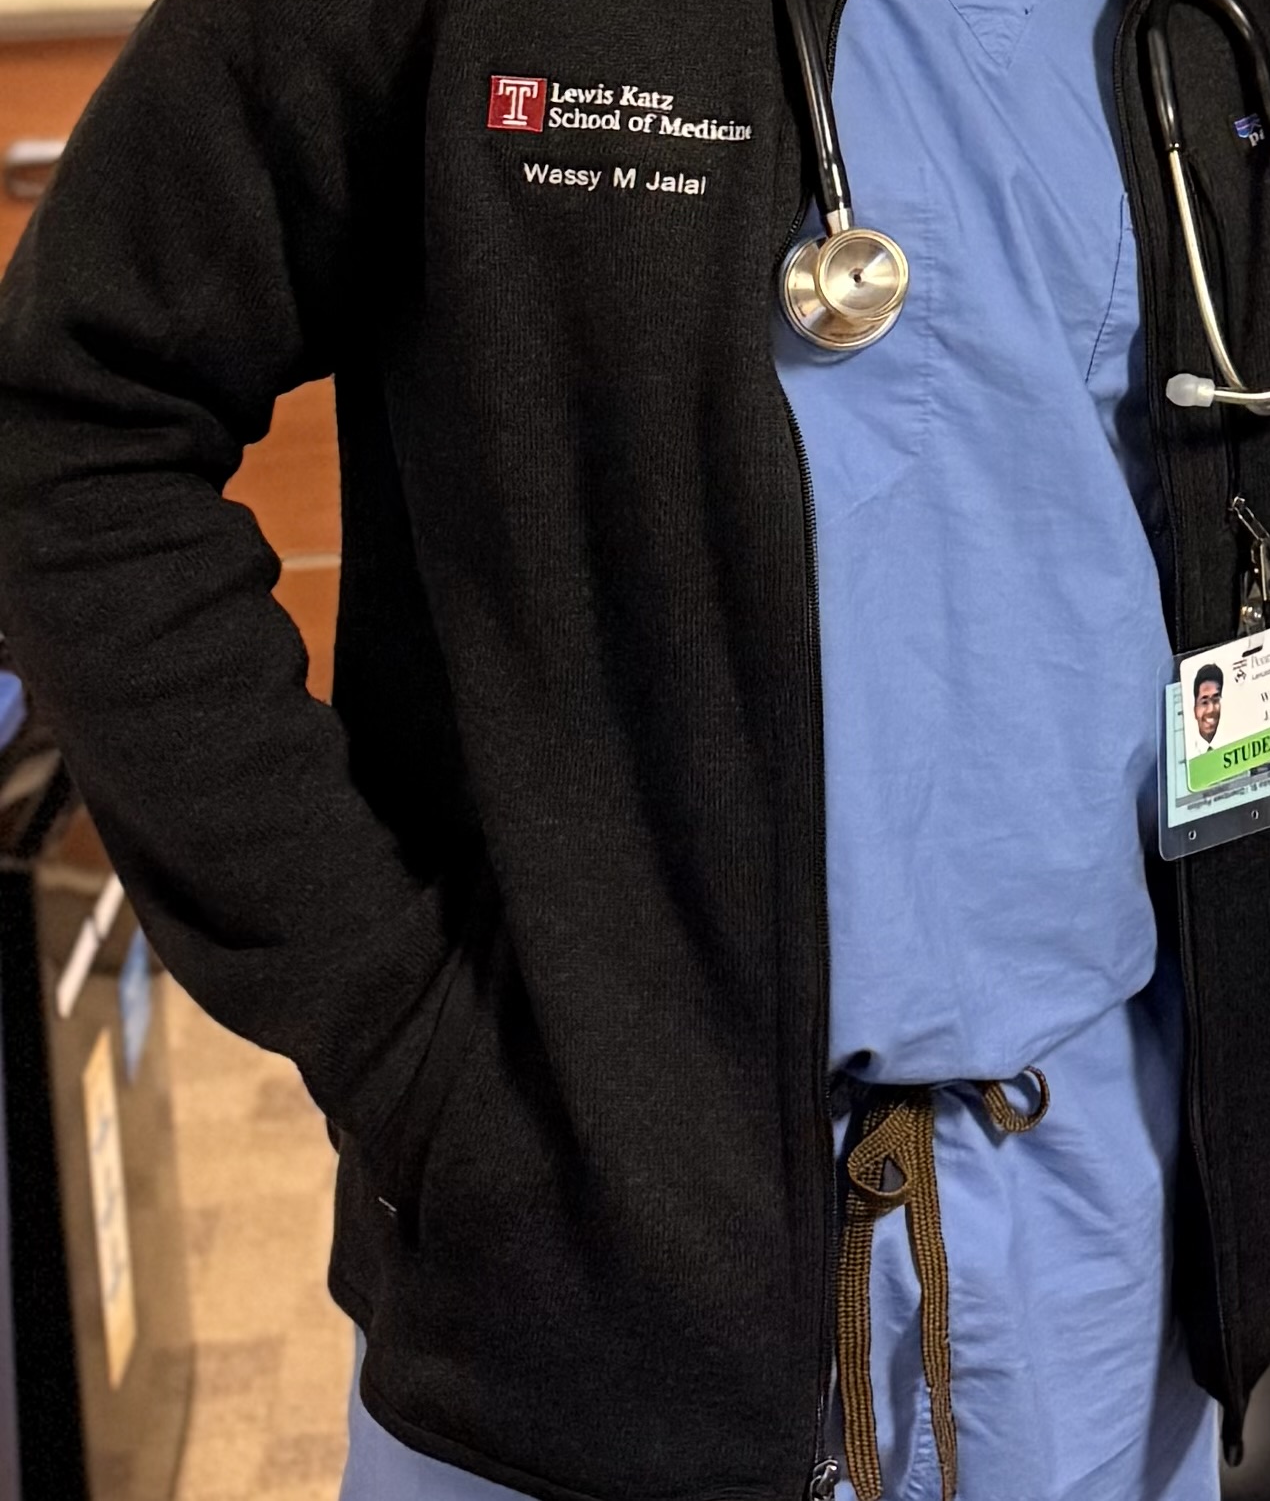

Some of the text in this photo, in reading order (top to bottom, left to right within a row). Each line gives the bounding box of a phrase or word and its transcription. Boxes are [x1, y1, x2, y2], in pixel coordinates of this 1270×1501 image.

[499, 79, 540, 126] T
[550, 83, 674, 111] Lewis Katz
[549, 107, 621, 131] School
[628, 113, 656, 133] of
[523, 162, 707, 196] Wassy M Jalal
